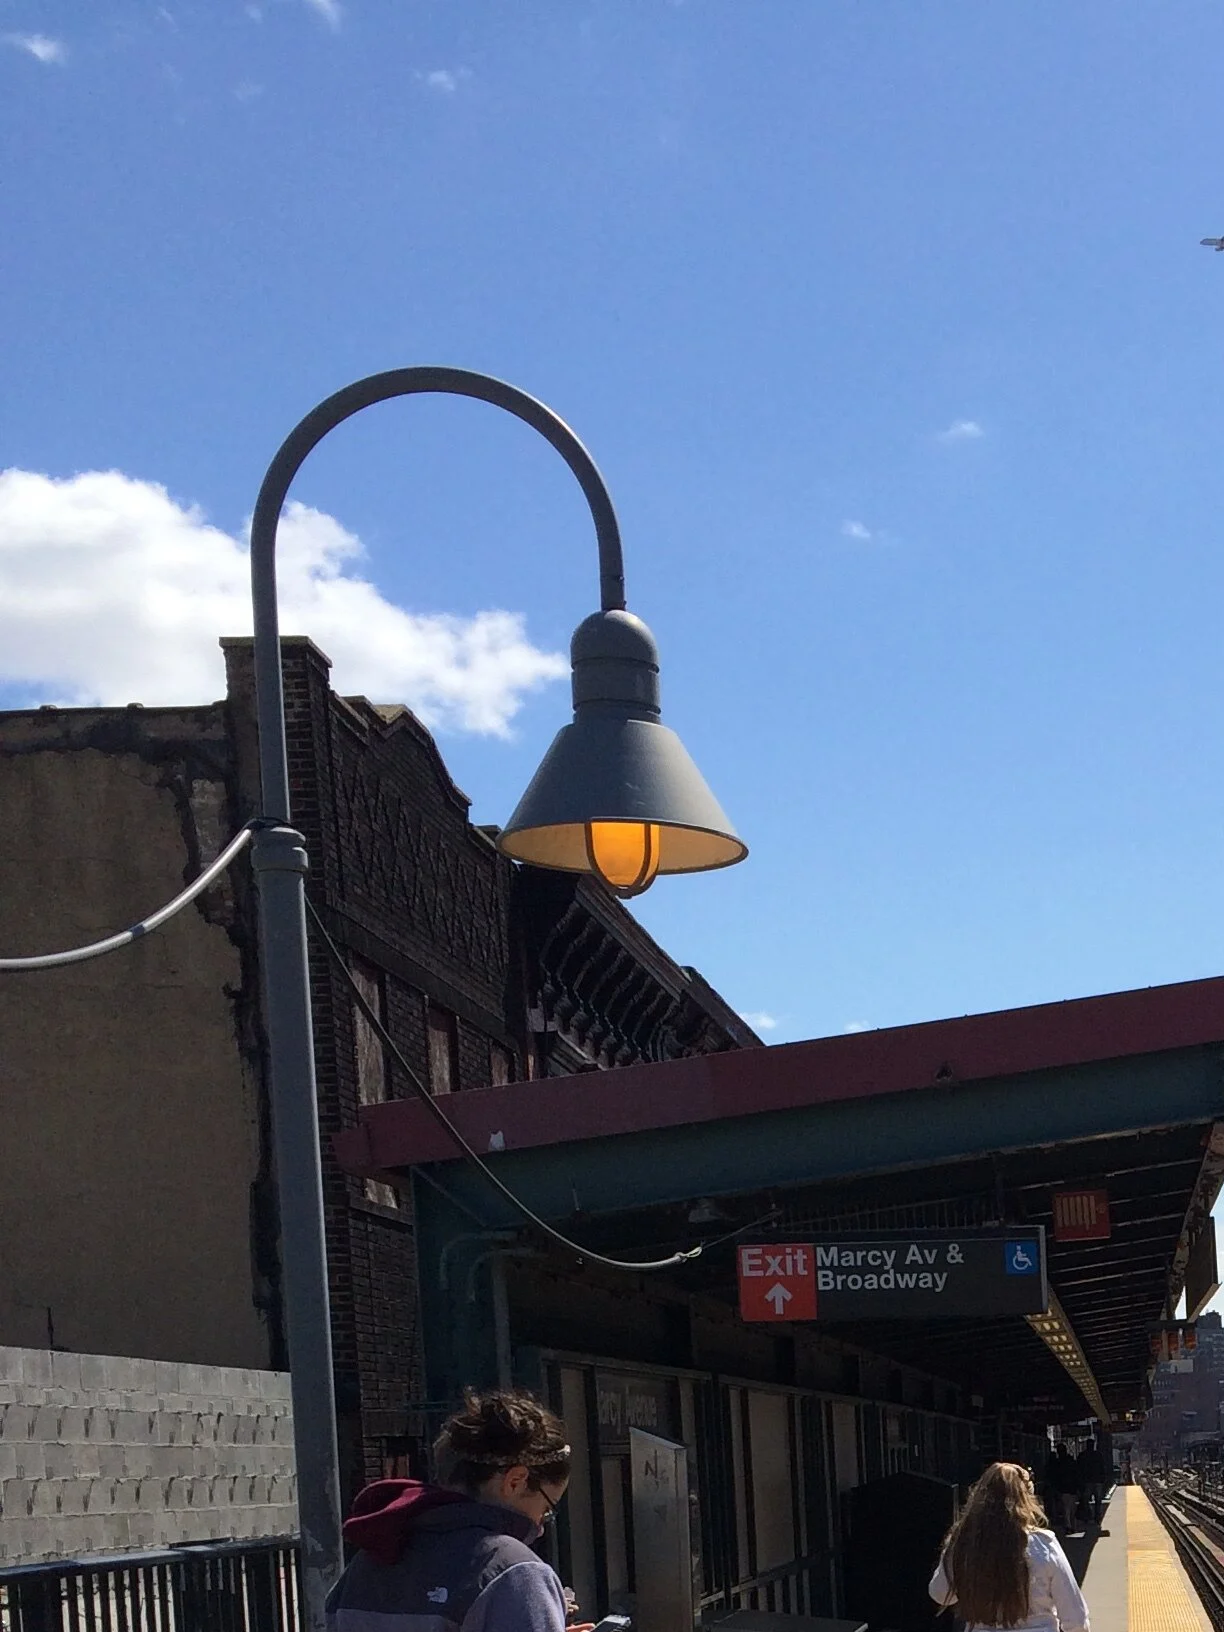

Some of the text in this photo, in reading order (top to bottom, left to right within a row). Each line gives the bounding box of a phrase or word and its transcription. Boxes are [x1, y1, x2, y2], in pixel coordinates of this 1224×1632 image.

[741, 1247, 809, 1277] Exit
[816, 1243, 965, 1270] Marcy Av &
[817, 1269, 949, 1293] Broadway
